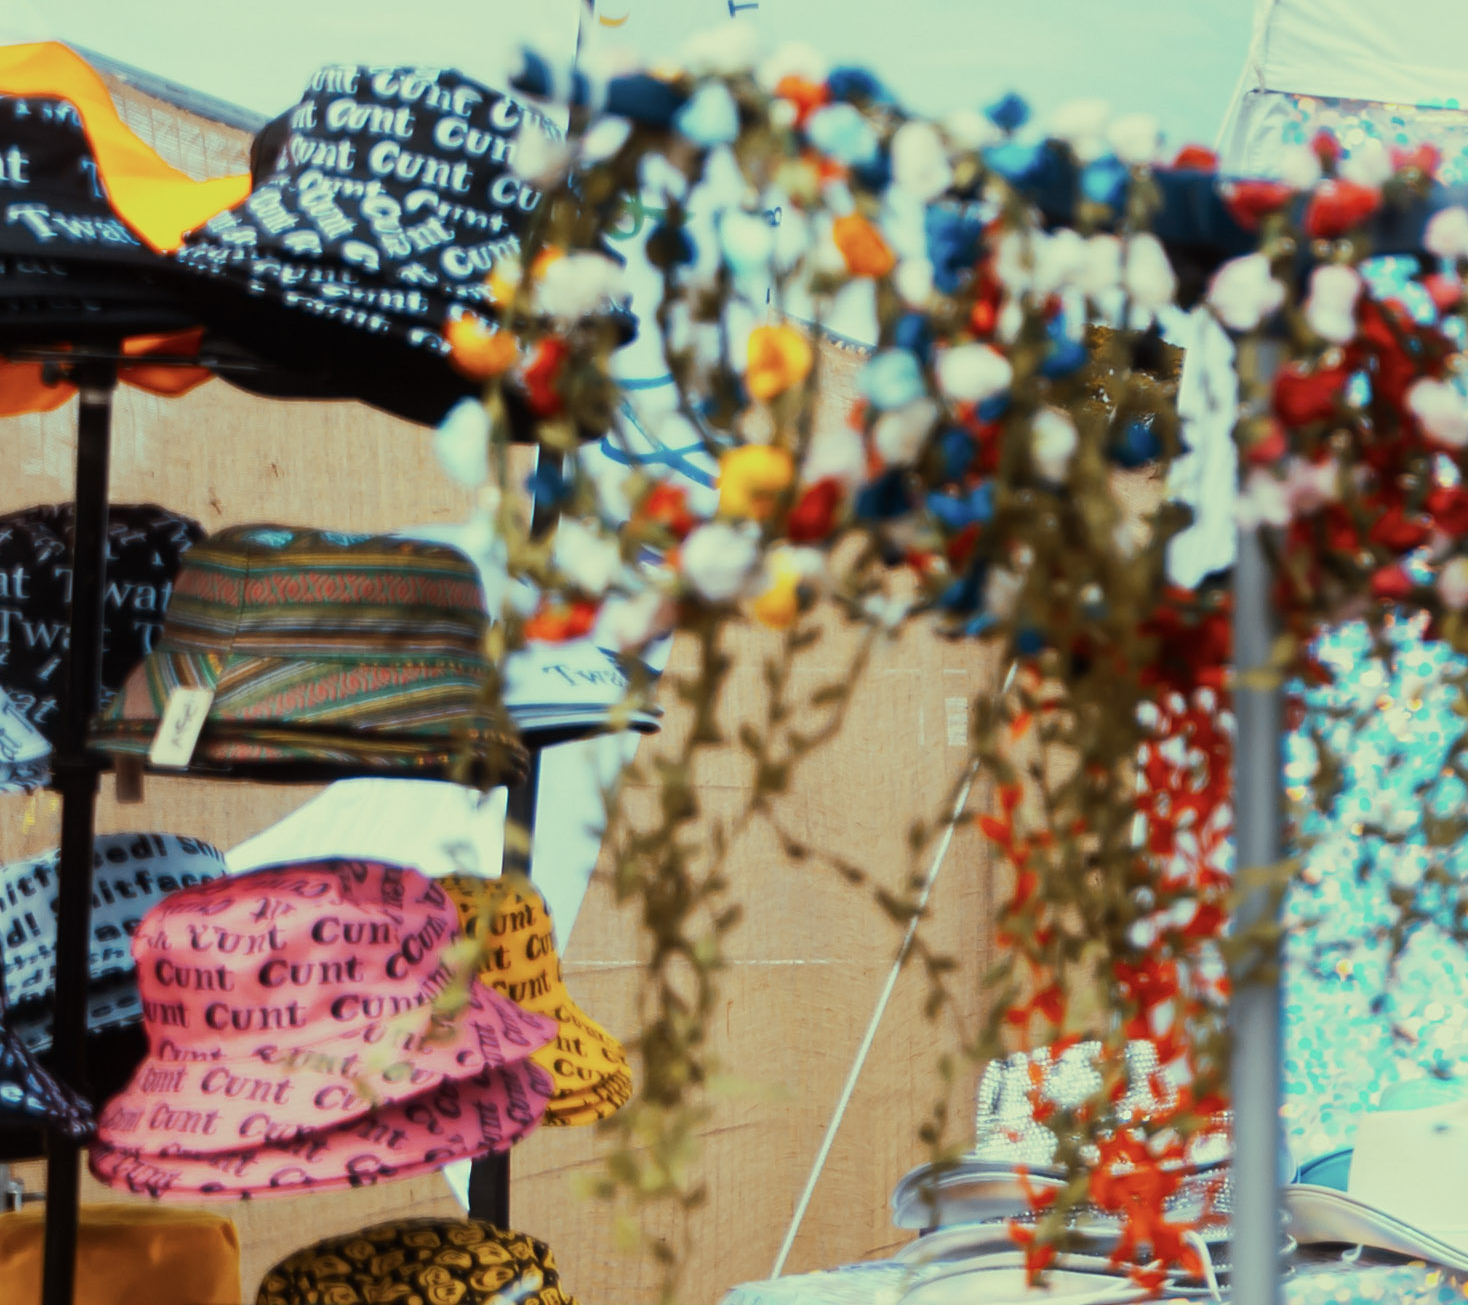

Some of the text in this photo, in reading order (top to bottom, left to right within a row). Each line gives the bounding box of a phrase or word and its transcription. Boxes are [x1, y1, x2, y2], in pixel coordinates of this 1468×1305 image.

[372, 71, 483, 117] Cunt
[326, 97, 415, 138] Cunt
[368, 139, 474, 193] Cunt
[154, 955, 364, 993] Cunt Cunt
[204, 999, 308, 1032] Cunt
[200, 1066, 296, 1106] Cunt
[148, 1102, 225, 1136] Cunt
